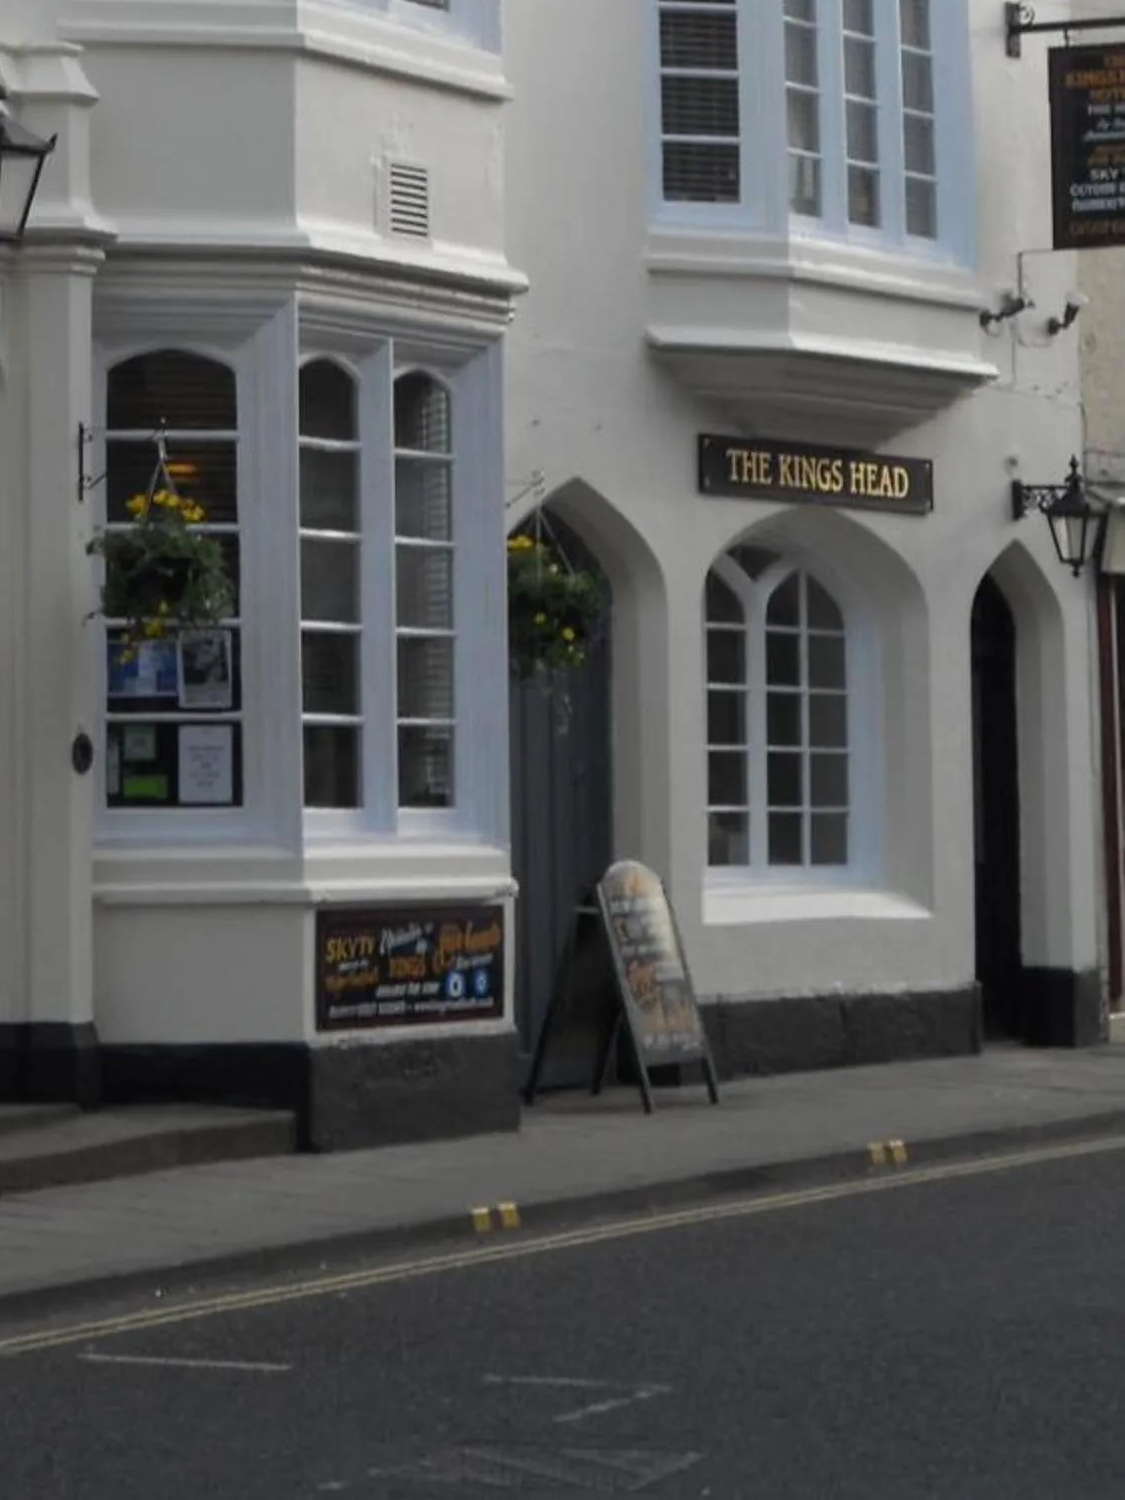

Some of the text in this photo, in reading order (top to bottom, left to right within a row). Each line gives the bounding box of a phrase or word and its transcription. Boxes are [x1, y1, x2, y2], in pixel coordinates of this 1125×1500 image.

[726, 448, 909, 498] THE KINGS HEAD
